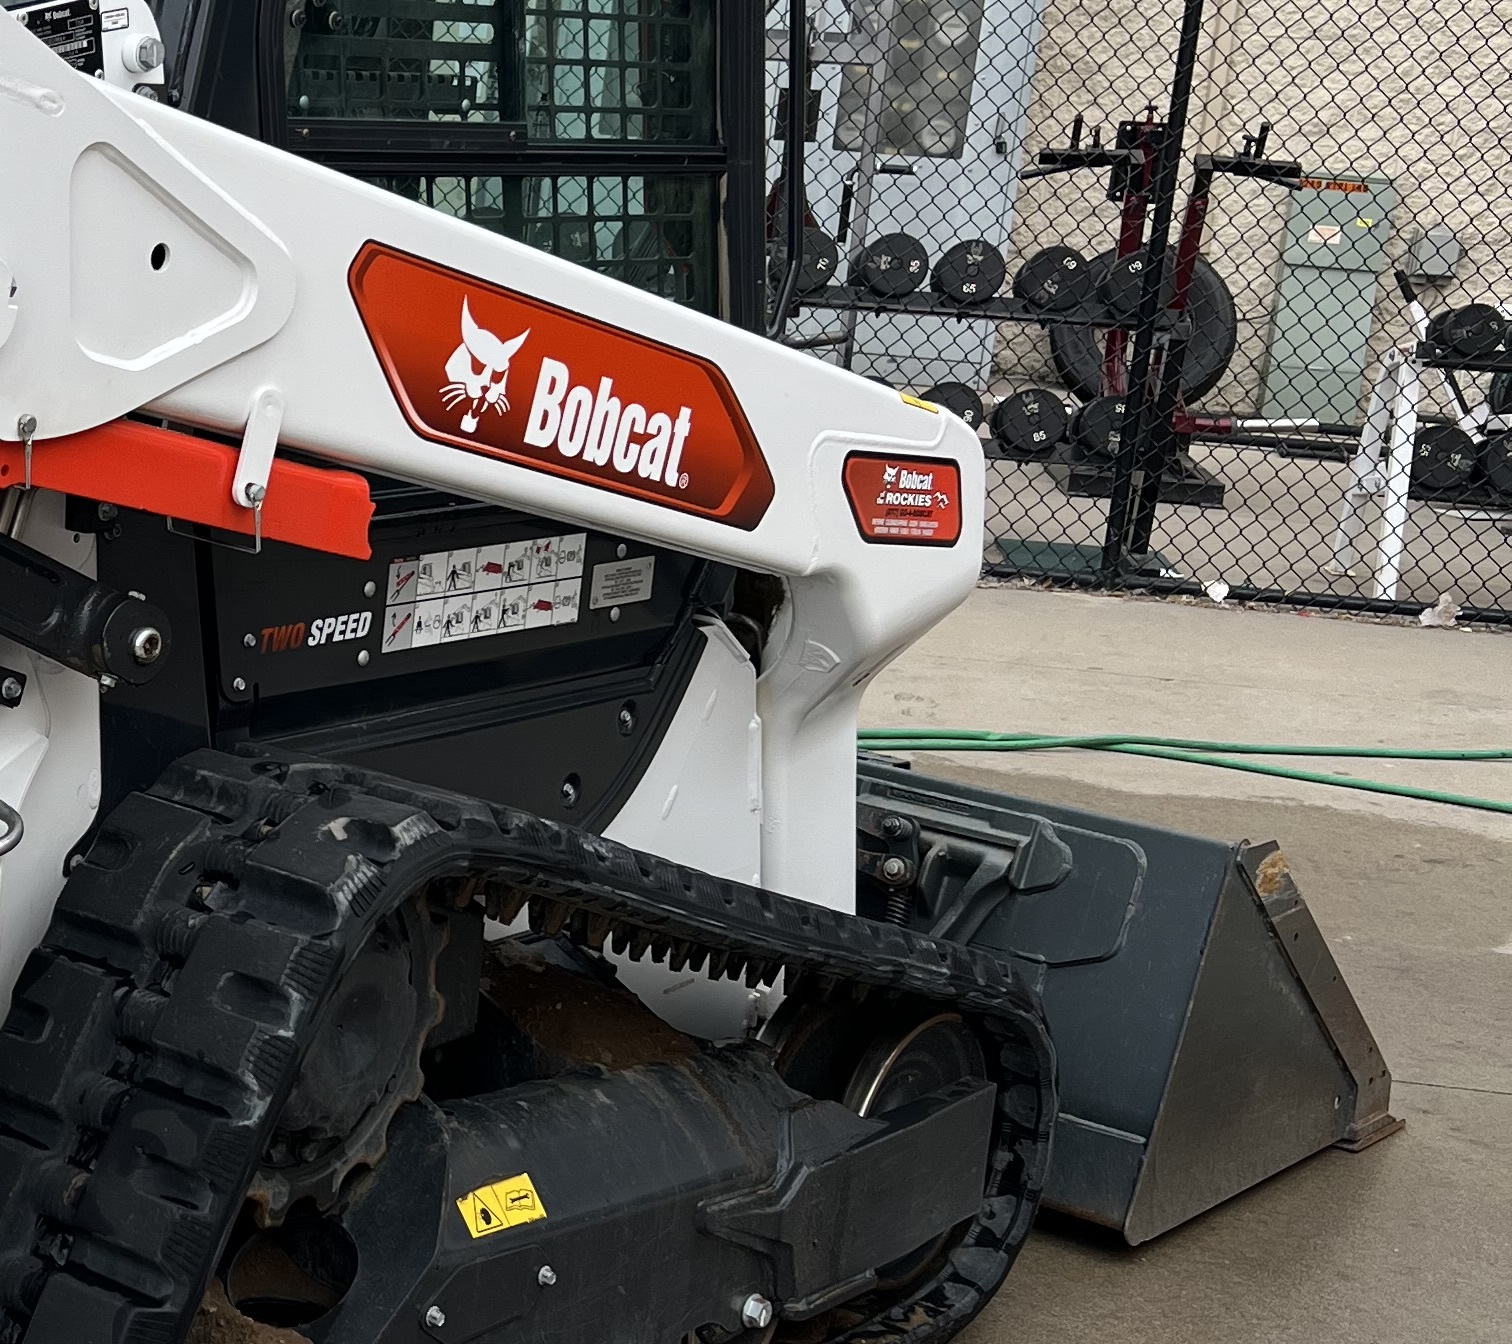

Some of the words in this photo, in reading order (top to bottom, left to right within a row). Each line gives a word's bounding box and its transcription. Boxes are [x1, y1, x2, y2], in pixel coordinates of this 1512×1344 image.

[524, 357, 692, 489] Bobcat
[899, 469, 933, 490] Bobcat
[886, 492, 933, 507] ROCKIES
[260, 622, 305, 654] TWO
[307, 611, 373, 647] SPEED
